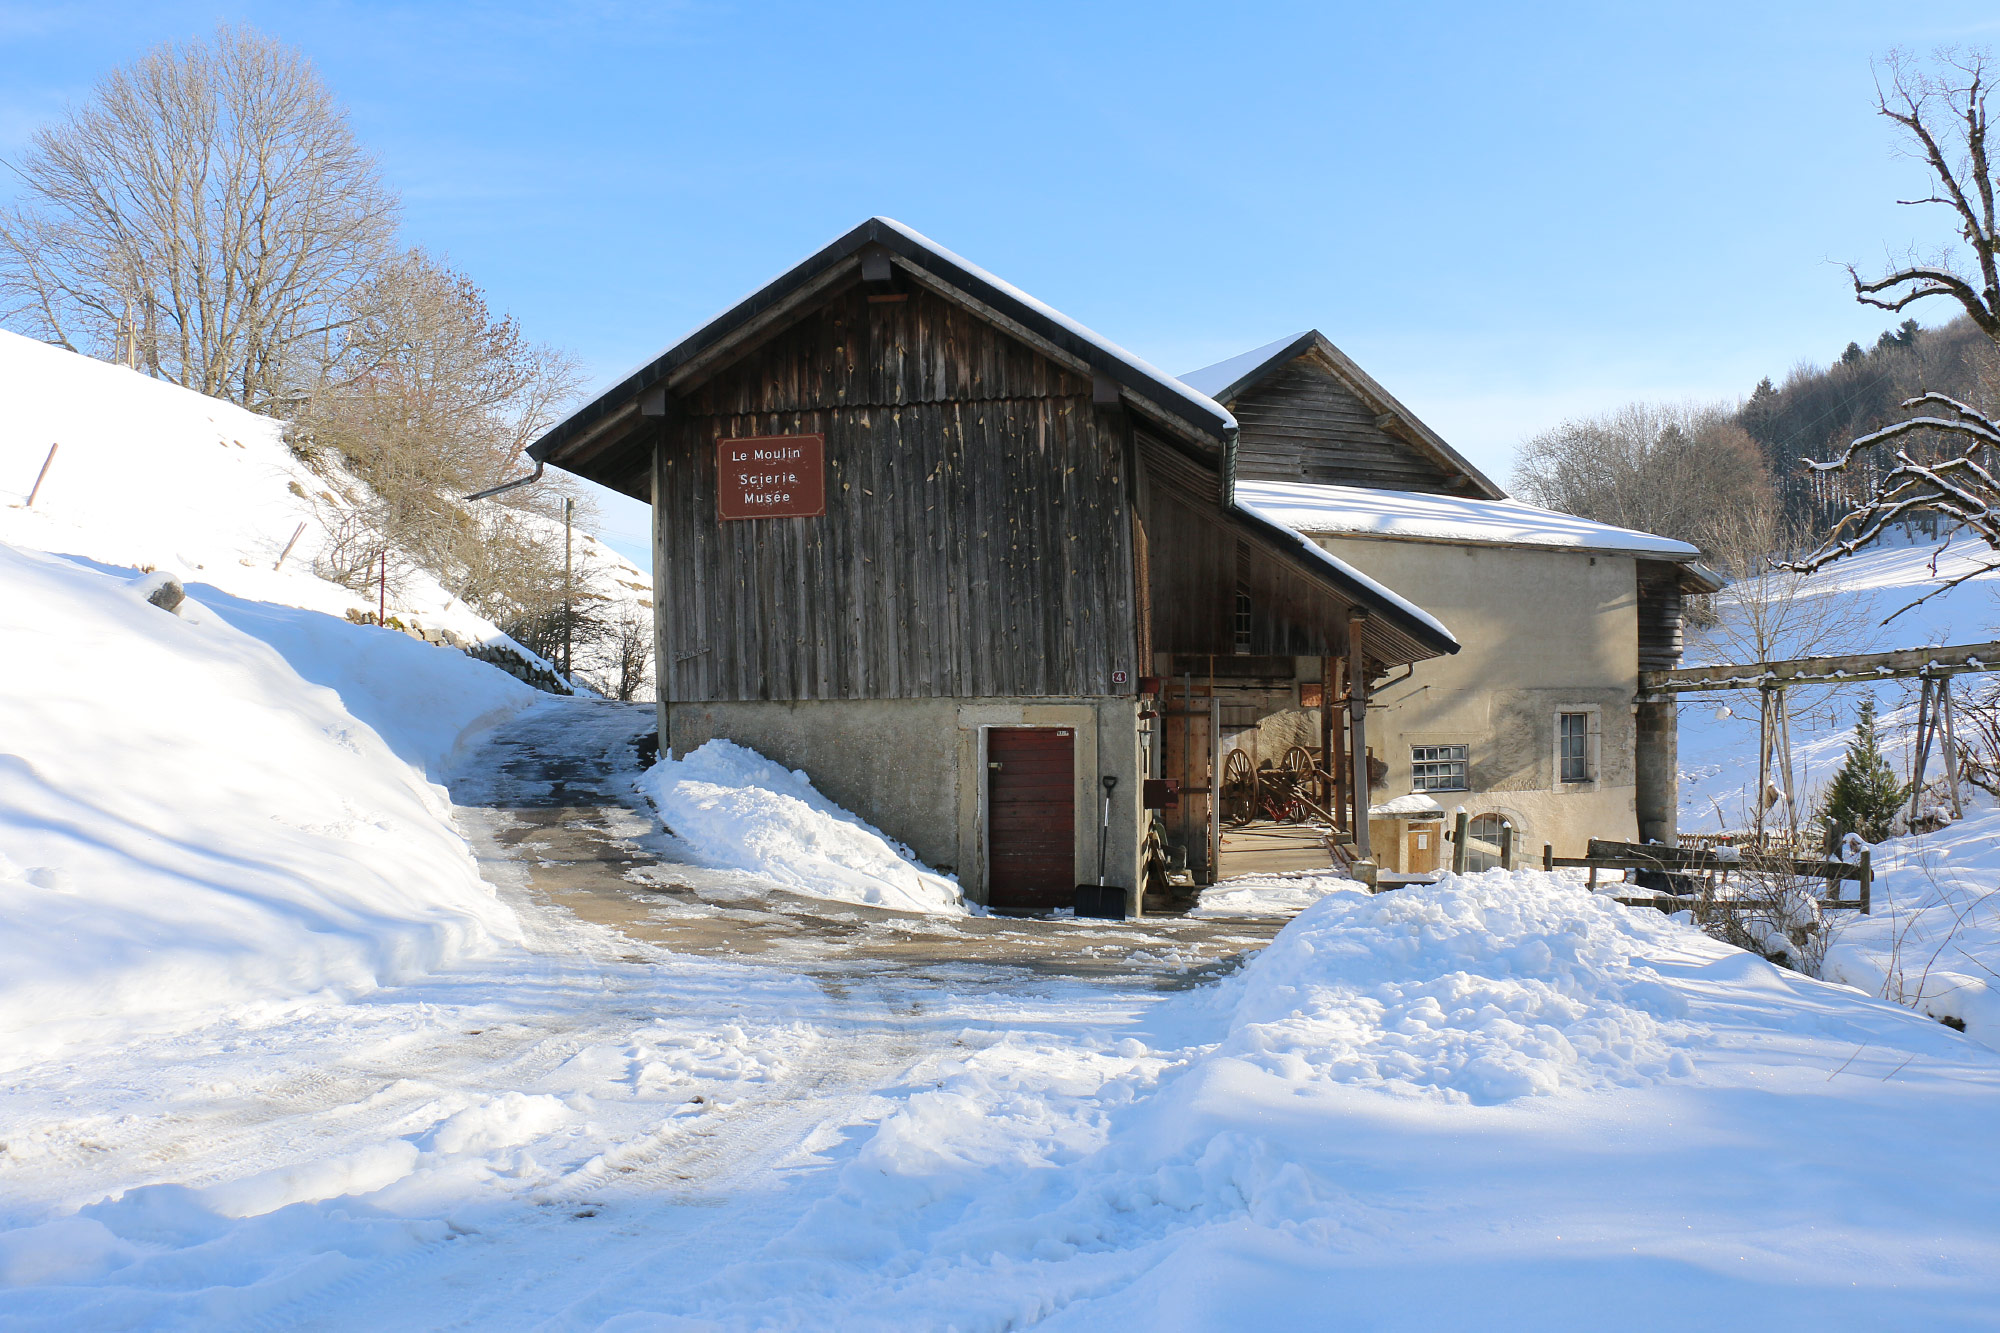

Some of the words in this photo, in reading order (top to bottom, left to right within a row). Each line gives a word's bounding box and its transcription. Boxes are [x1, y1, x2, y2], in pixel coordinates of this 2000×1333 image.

[732, 451, 748, 461] Le
[754, 447, 800, 460] Moulin
[740, 472, 797, 485] Scierie
[744, 490, 790, 504] Musée
[1116, 673, 1122, 682] 4
